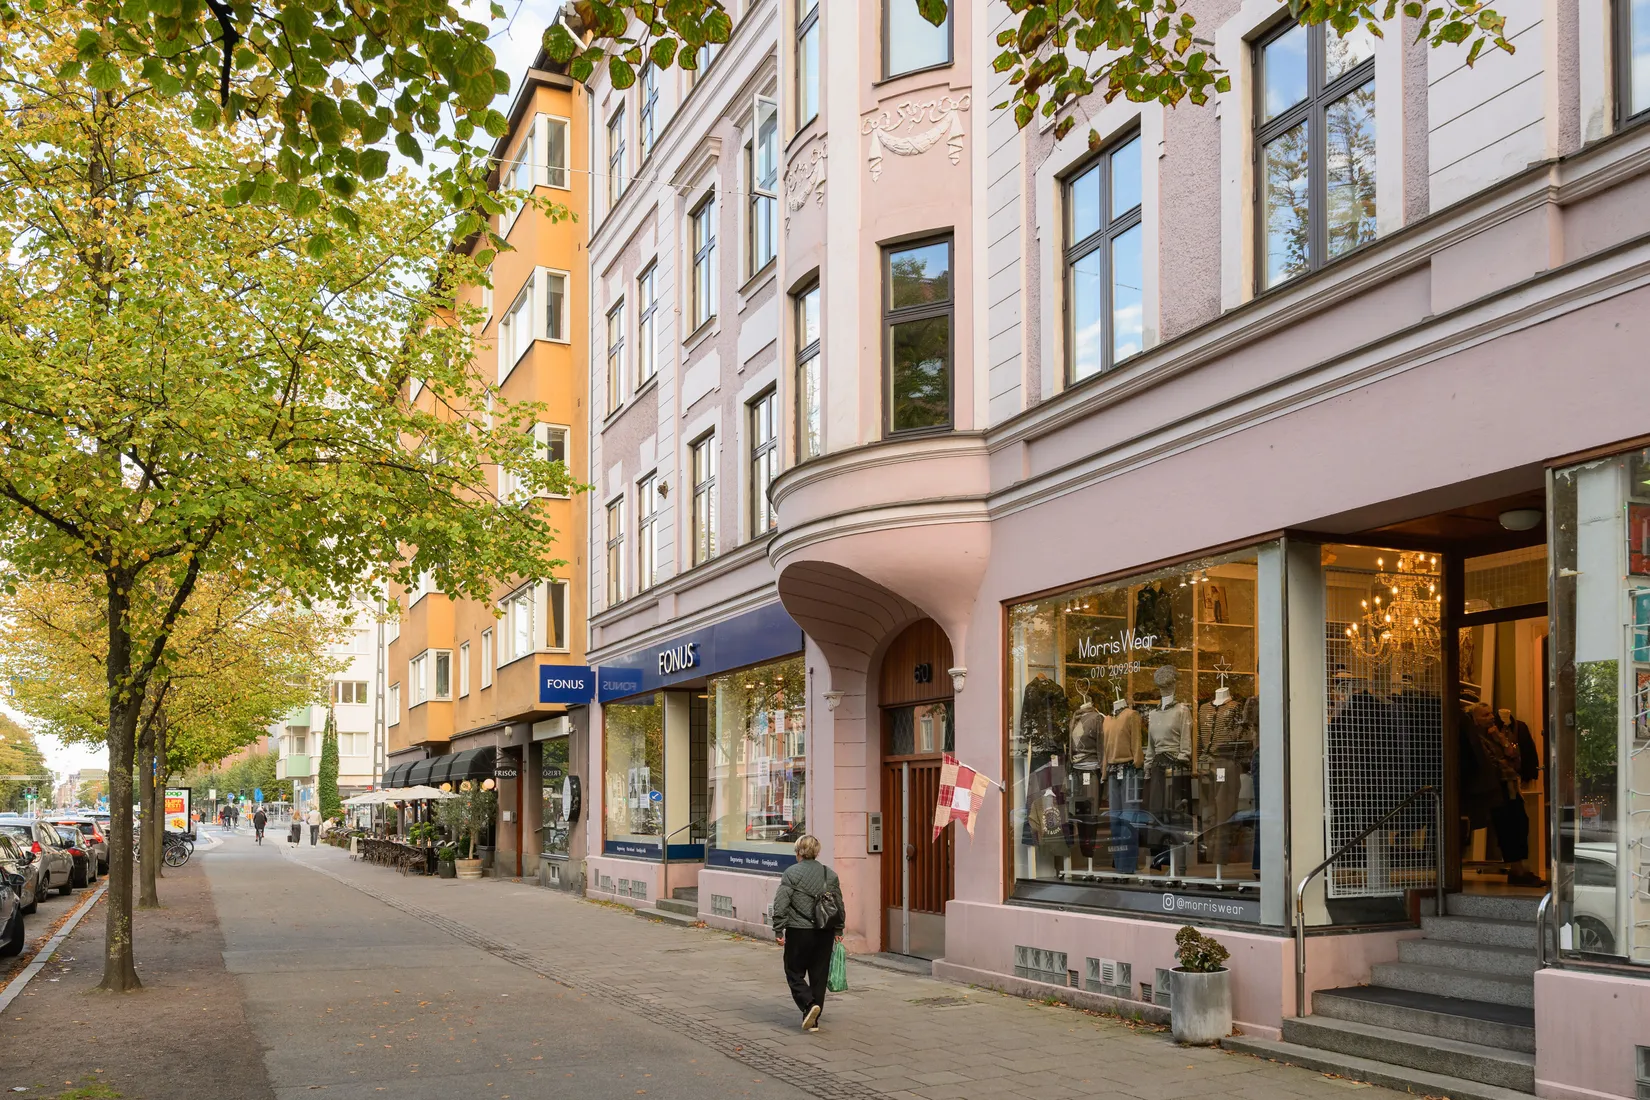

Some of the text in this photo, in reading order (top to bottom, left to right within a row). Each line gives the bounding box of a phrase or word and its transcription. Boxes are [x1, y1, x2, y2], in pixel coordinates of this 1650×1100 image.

[659, 642, 694, 675] FONUS
[1090, 660, 1141, 679] 070 2092581
[547, 678, 584, 690] FONUS
[1176, 897, 1245, 915] @morriswear
